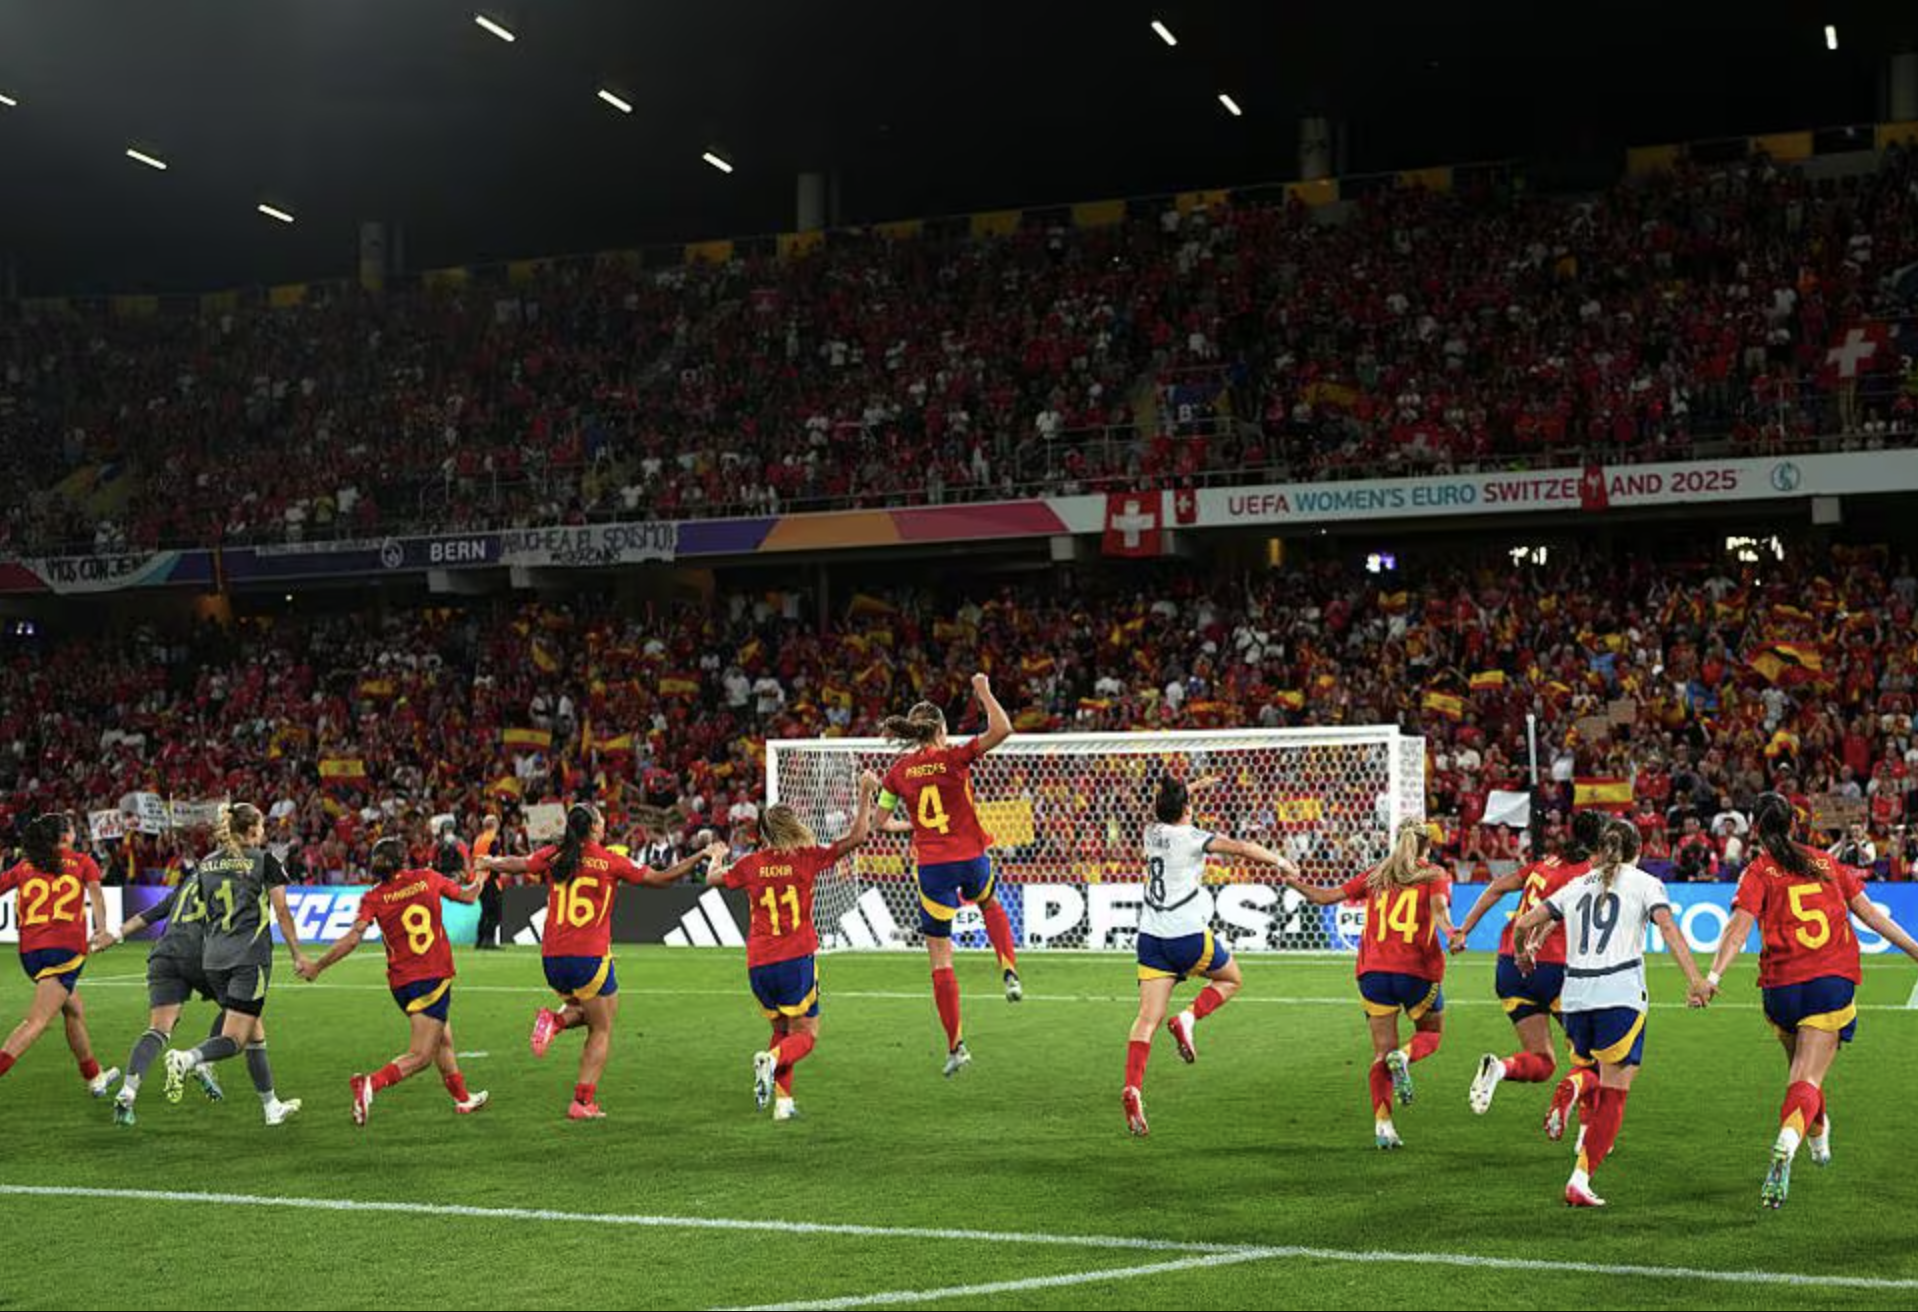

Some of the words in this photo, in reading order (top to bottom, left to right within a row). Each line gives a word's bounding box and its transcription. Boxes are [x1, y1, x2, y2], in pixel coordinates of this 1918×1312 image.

[1228, 494, 1290, 516] UEFA
[1294, 487, 1406, 512] WOMEN'S
[1412, 484, 1476, 507] EURO
[1483, 472, 1662, 503] SWITZEAND
[1670, 469, 1738, 493] 2025
[429, 540, 487, 562] BERN
[917, 784, 950, 835] 4
[22, 873, 81, 926] 22
[214, 879, 234, 931] 1
[553, 876, 599, 928] 16
[759, 885, 801, 936] 11
[1374, 889, 1419, 944] 14
[1574, 892, 1621, 956] 19
[1787, 882, 1831, 951] 5
[401, 903, 435, 955] 8
